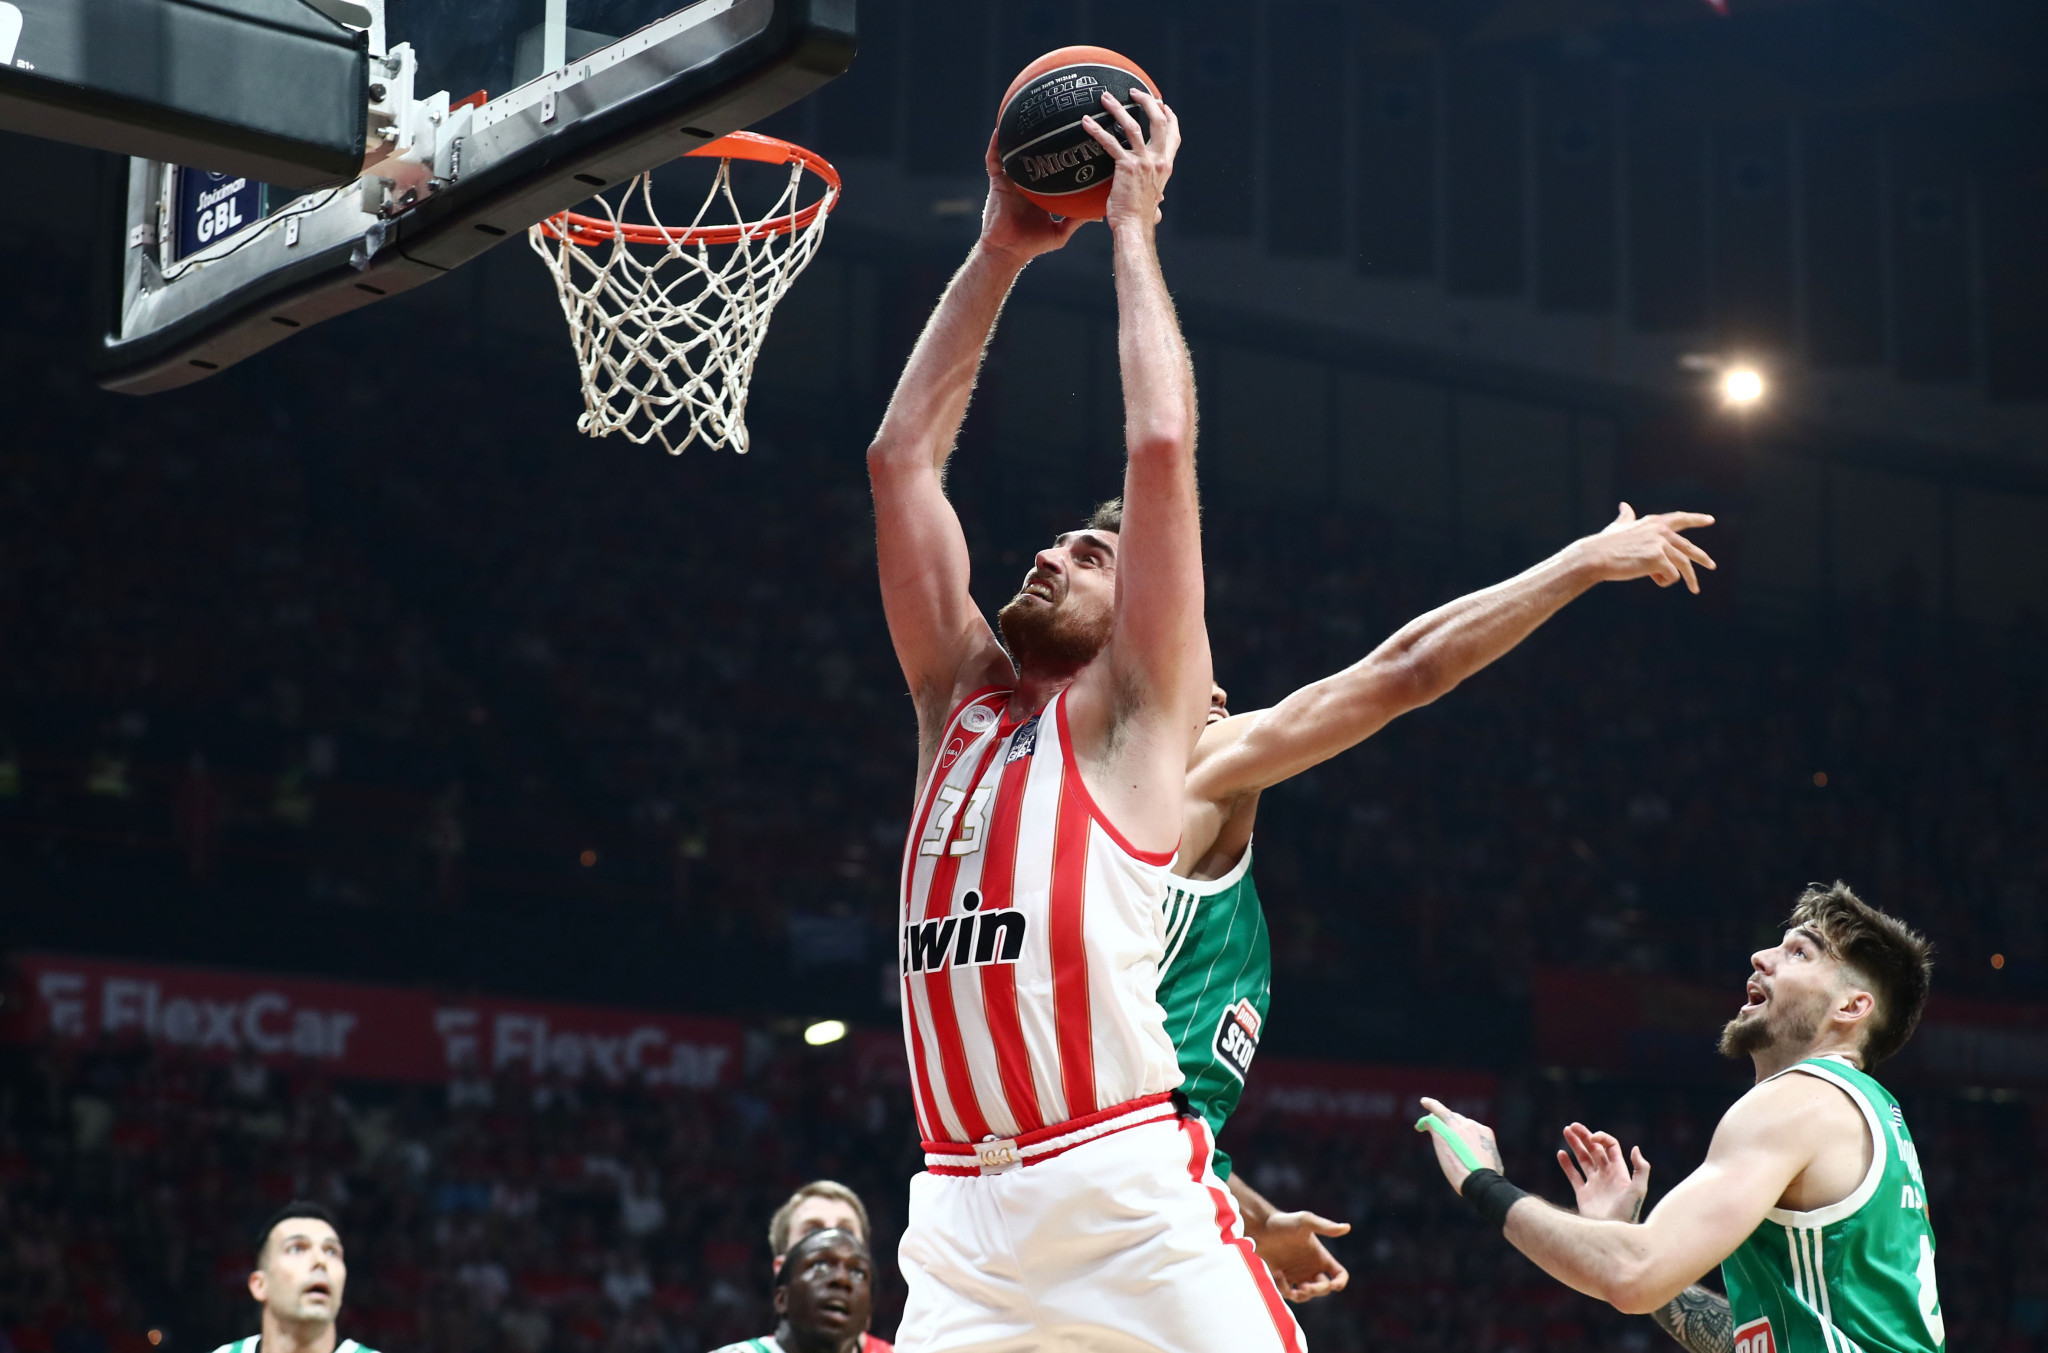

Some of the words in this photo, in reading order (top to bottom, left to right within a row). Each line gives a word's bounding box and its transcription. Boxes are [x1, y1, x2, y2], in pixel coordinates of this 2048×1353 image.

[1017, 86, 1108, 135] LEGACY
[1020, 138, 1102, 181] ALDING
[197, 196, 243, 243] GBL
[920, 785, 993, 857] 33
[903, 888, 1028, 976] win
[101, 978, 359, 1058] FlexCar
[492, 1011, 731, 1088] FlexCar
